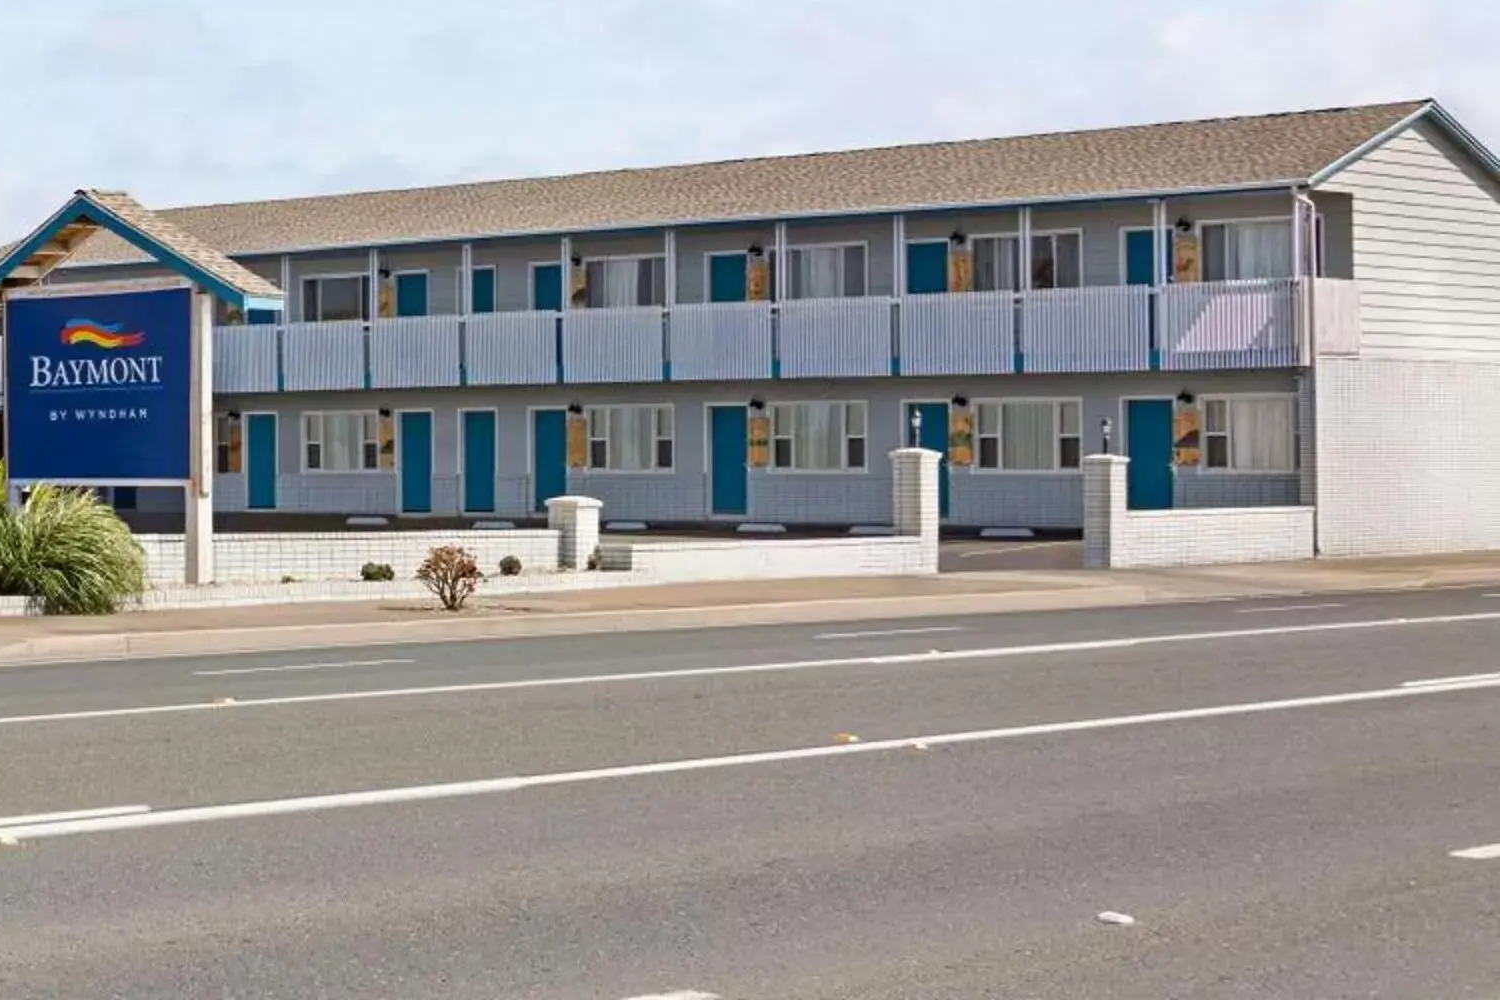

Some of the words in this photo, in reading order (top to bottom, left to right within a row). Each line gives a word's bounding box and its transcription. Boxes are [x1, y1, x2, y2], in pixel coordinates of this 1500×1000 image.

[30, 356, 162, 387] BAYMONT
[50, 410, 67, 421] BY
[75, 408, 148, 420] WYNDHAM
